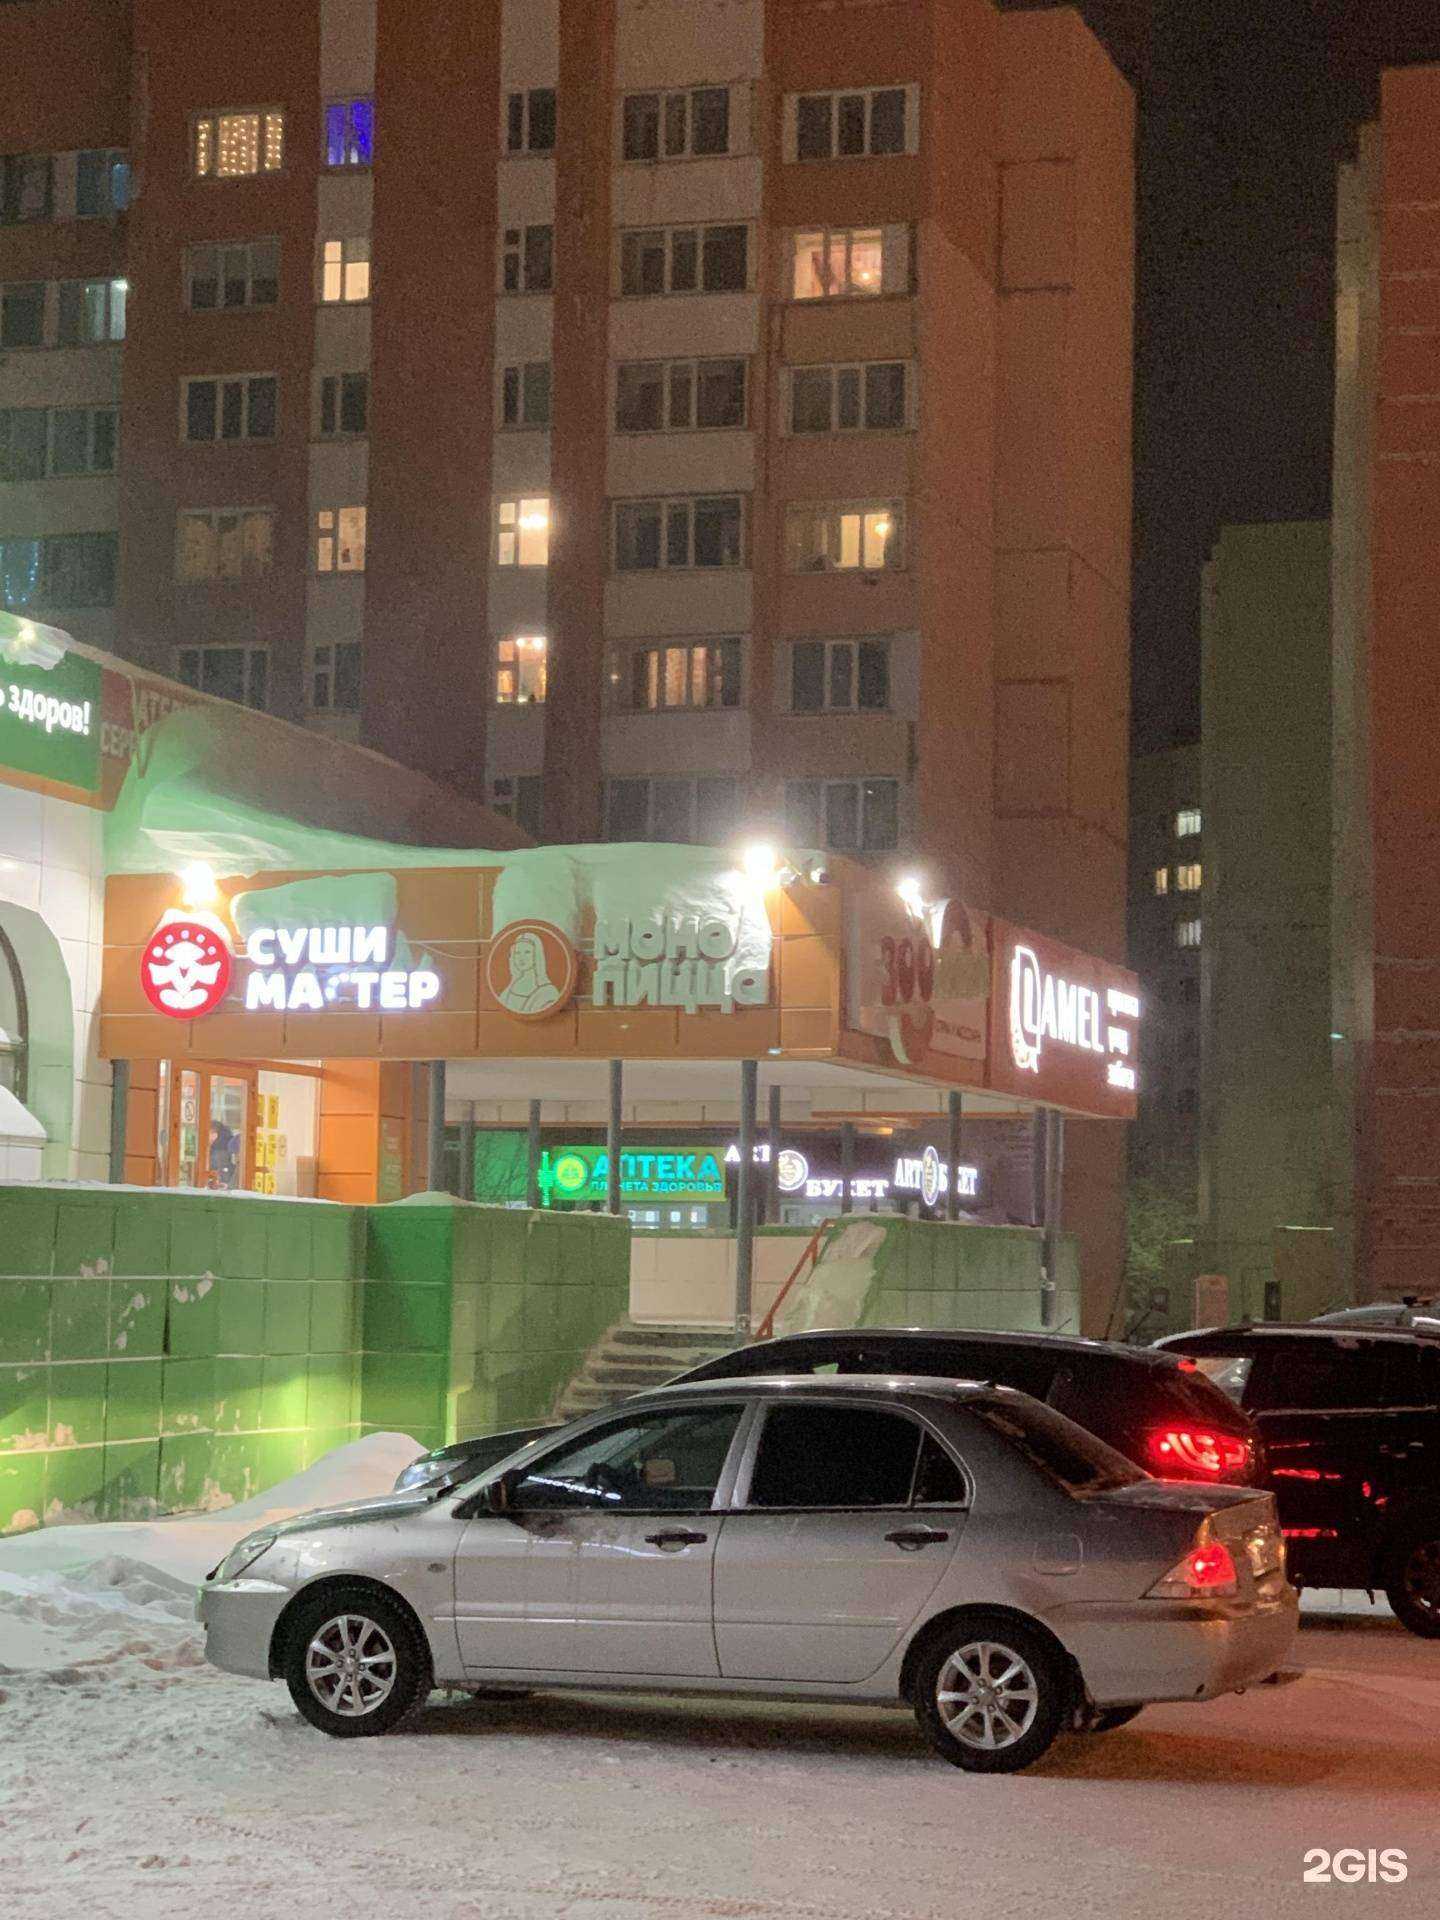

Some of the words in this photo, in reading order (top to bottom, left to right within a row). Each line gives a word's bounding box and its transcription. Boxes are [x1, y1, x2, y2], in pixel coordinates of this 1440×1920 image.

[8, 684, 91, 736] здоров!
[246, 925, 388, 965] СУШИ
[652, 1180, 723, 1194] ЗДОРОВЬЯ
